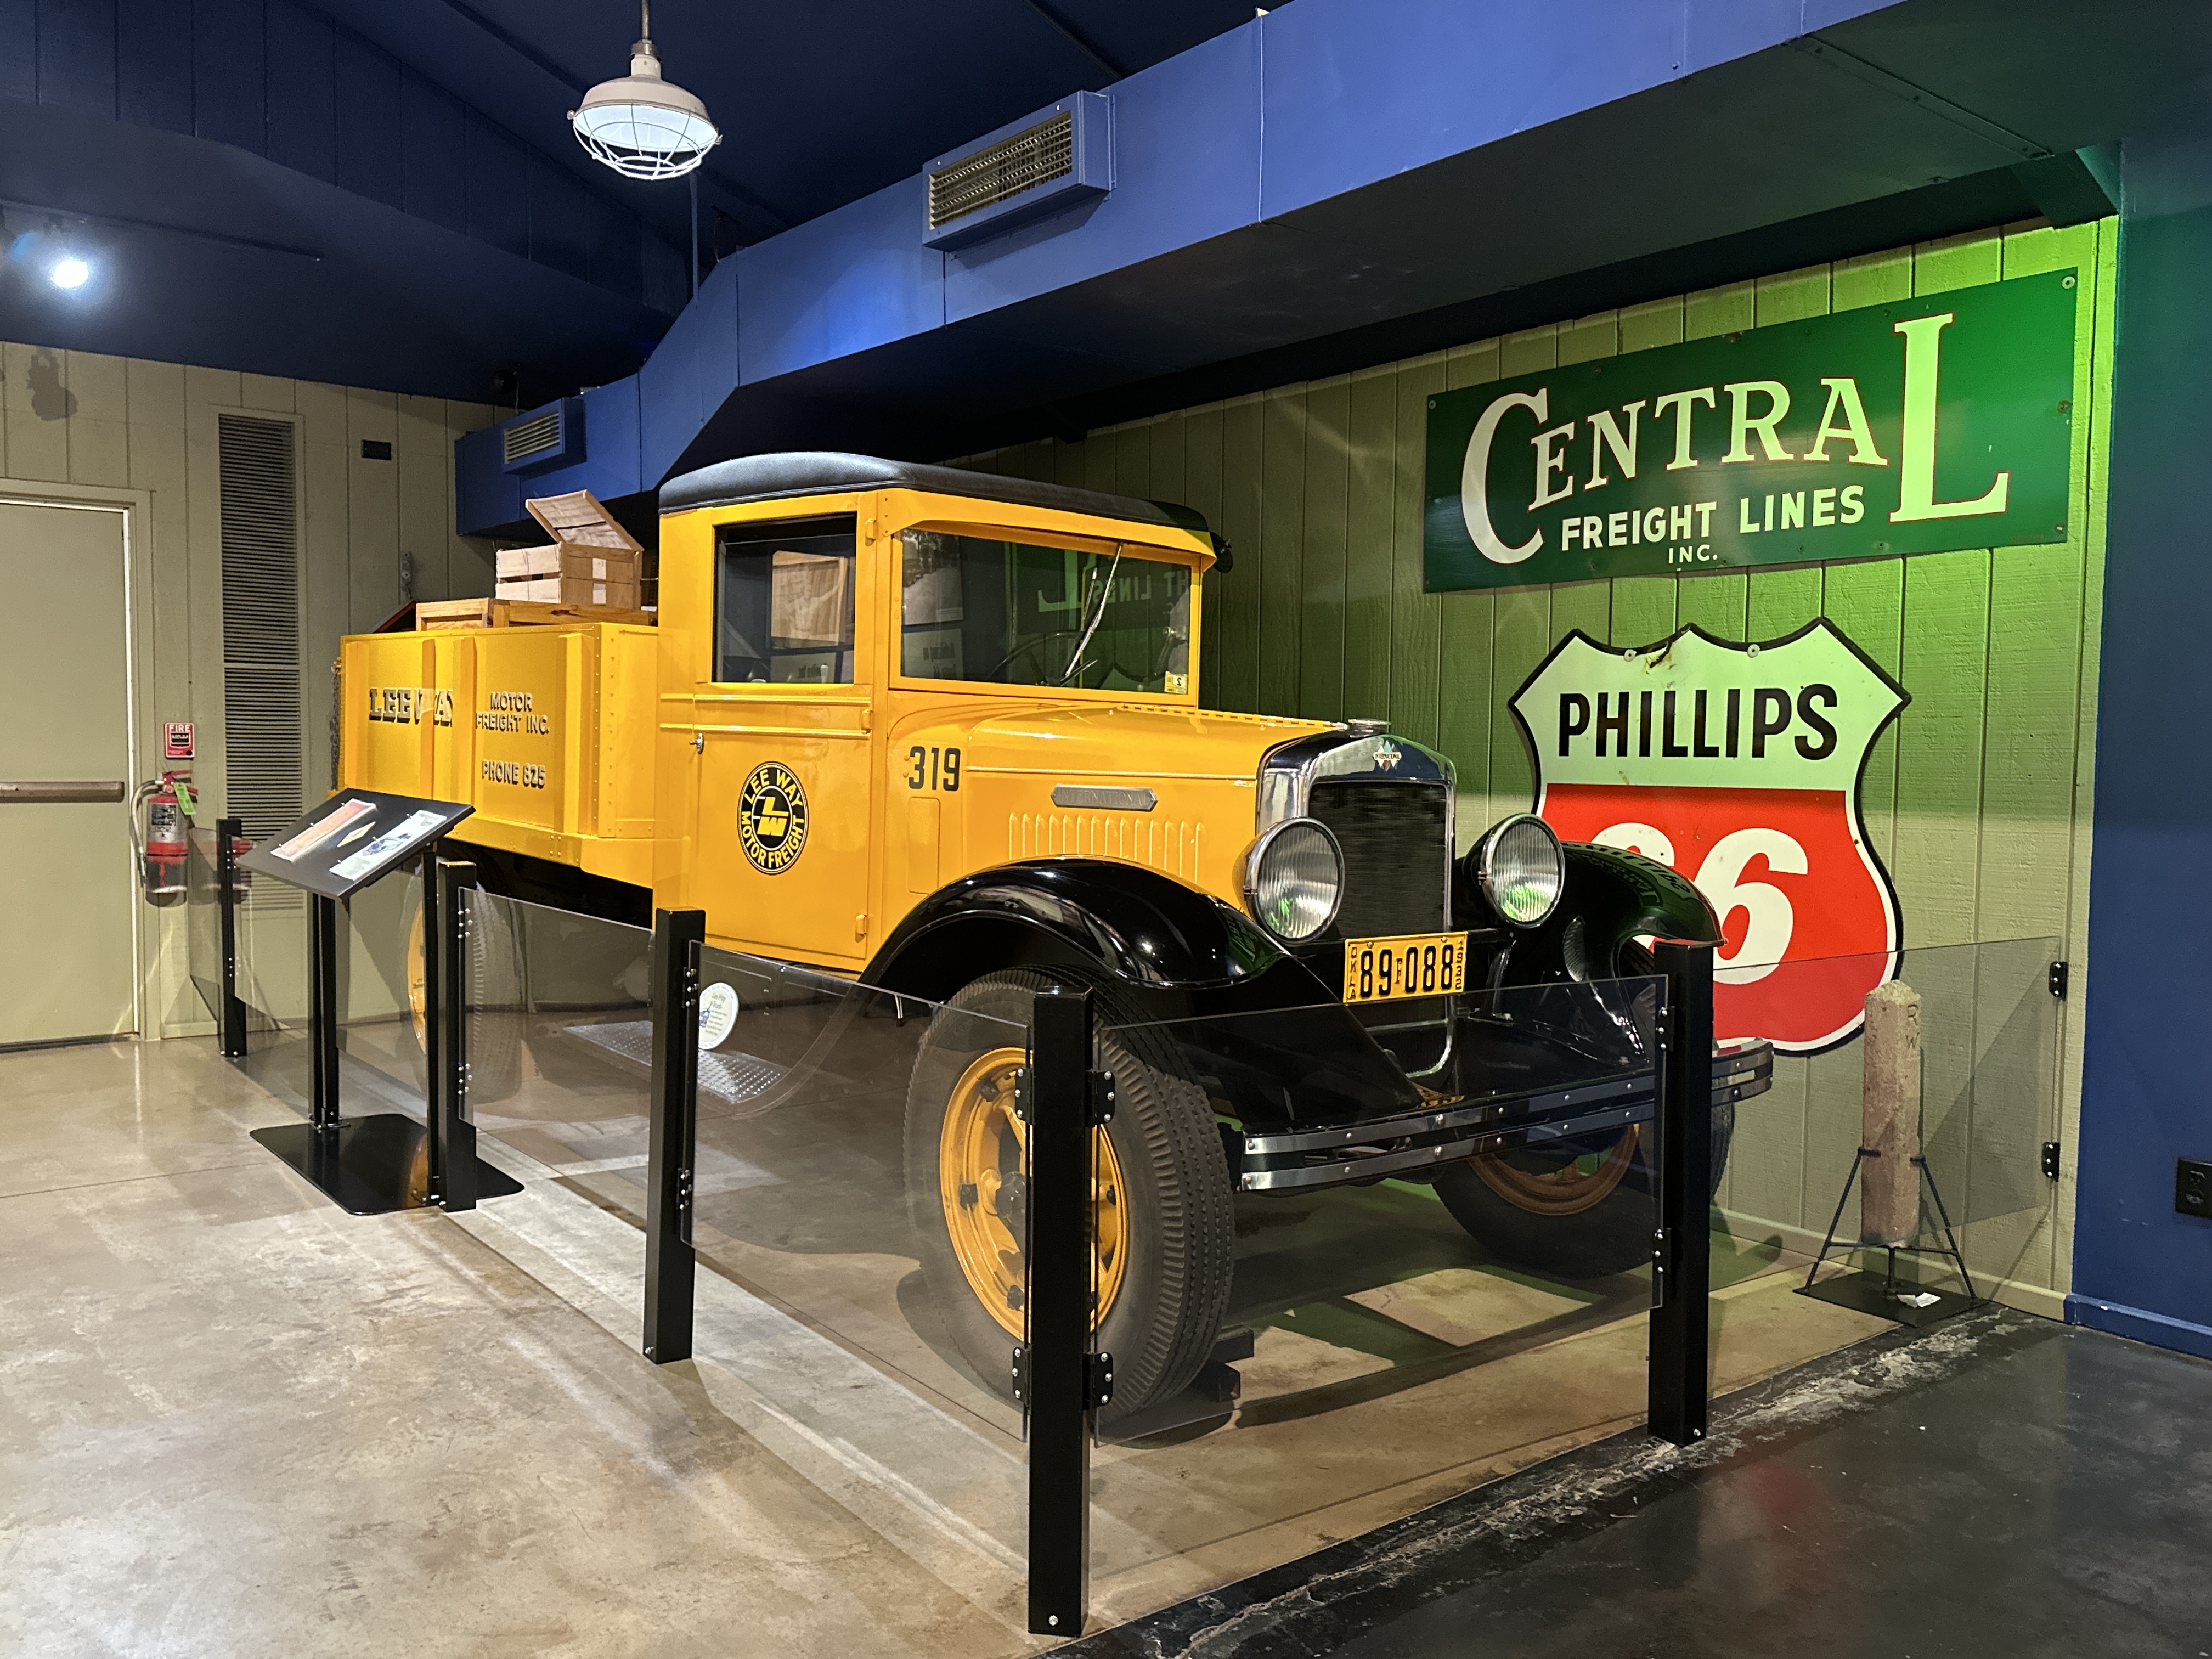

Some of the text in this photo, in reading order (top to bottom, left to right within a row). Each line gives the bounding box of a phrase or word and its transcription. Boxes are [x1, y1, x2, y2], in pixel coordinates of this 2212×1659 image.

[1461, 312, 2010, 566] CENTRAL
[1561, 484, 1866, 552] FREIGHT LINES
[1668, 544, 1718, 564] INC.
[369, 687, 411, 724] LEE
[490, 691, 533, 712] MOTOR
[169, 724, 191, 732] FIRE
[476, 712, 550, 735] FREIGHT INC.
[1558, 684, 1838, 760] PHILLIPS
[482, 759, 546, 789] PHONE 825
[909, 746, 961, 791] 319
[744, 769, 803, 807] LEE WAY
[1057, 789, 1149, 806] INTERNATIONAL
[741, 811, 805, 868] MOTOR FREIGHT
